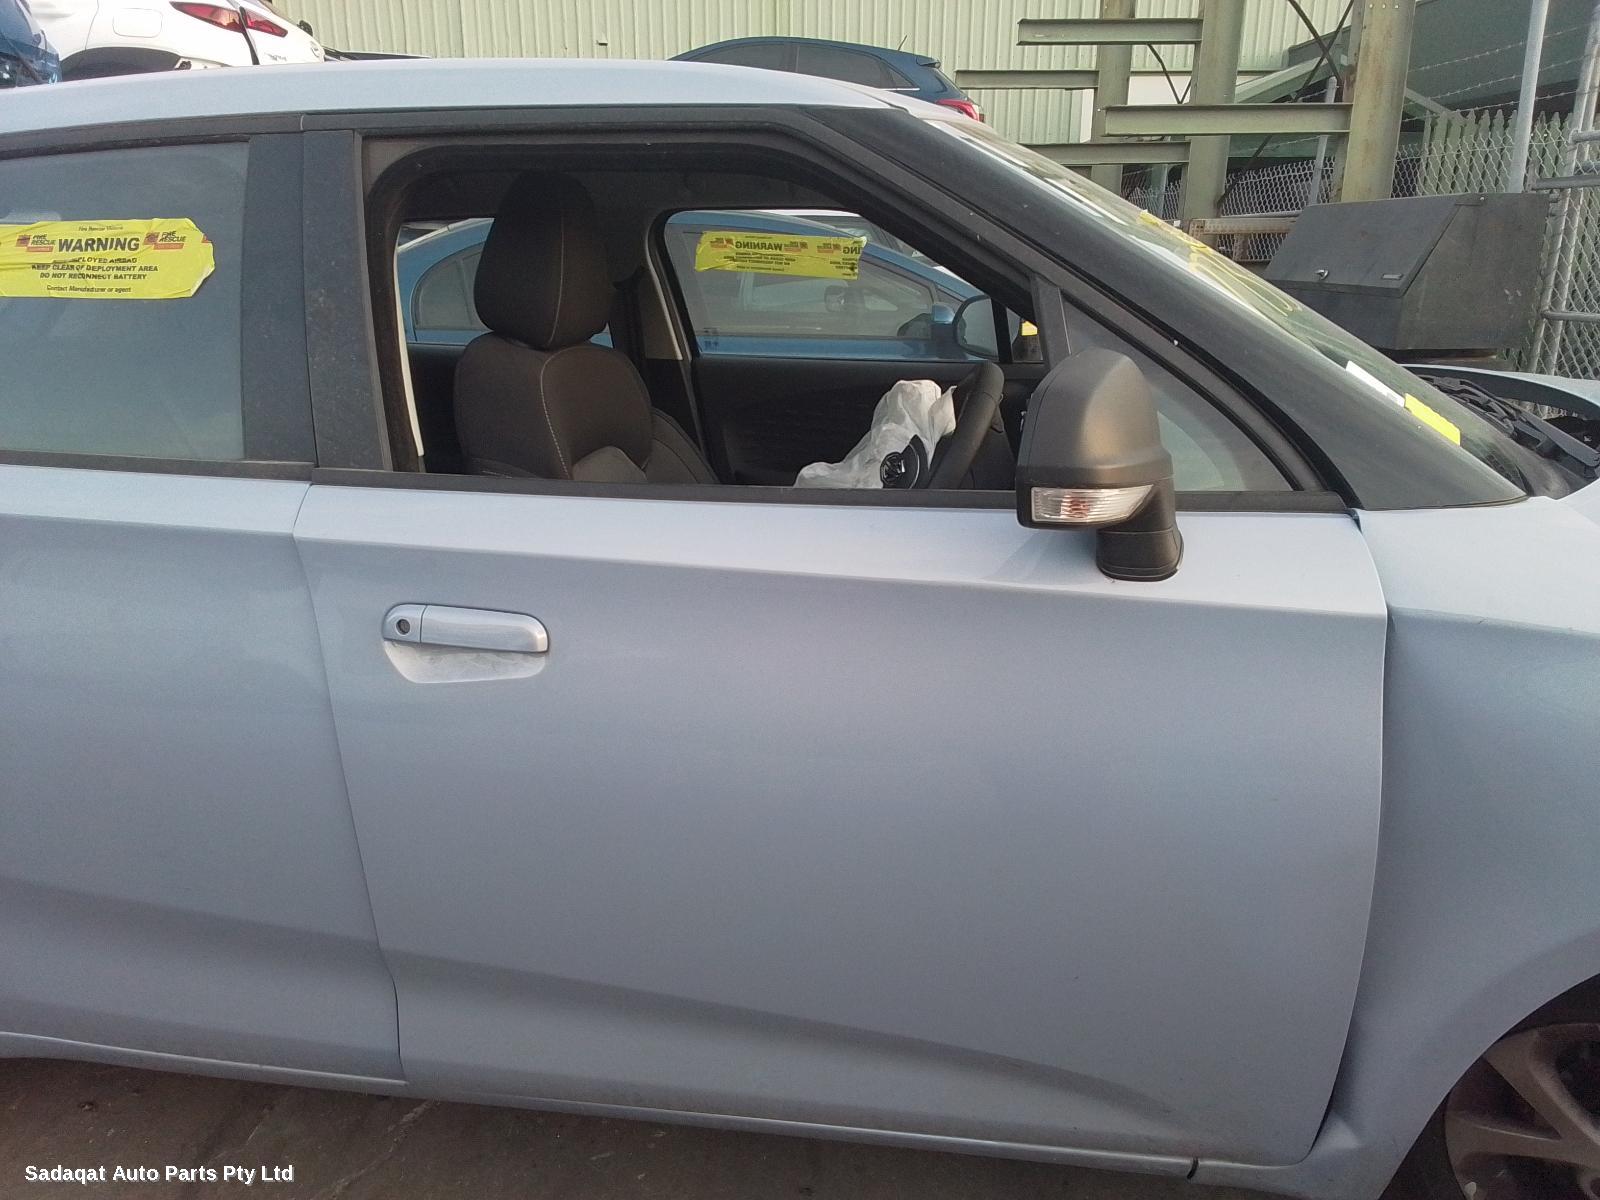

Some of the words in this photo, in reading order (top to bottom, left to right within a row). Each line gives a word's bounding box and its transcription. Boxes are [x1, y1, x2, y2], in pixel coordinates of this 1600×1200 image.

[58, 236, 140, 253] WARNING
[85, 264, 137, 272] DEPLOYMENT
[68, 272, 112, 280] RECONNECT
[114, 286, 132, 294] agent
